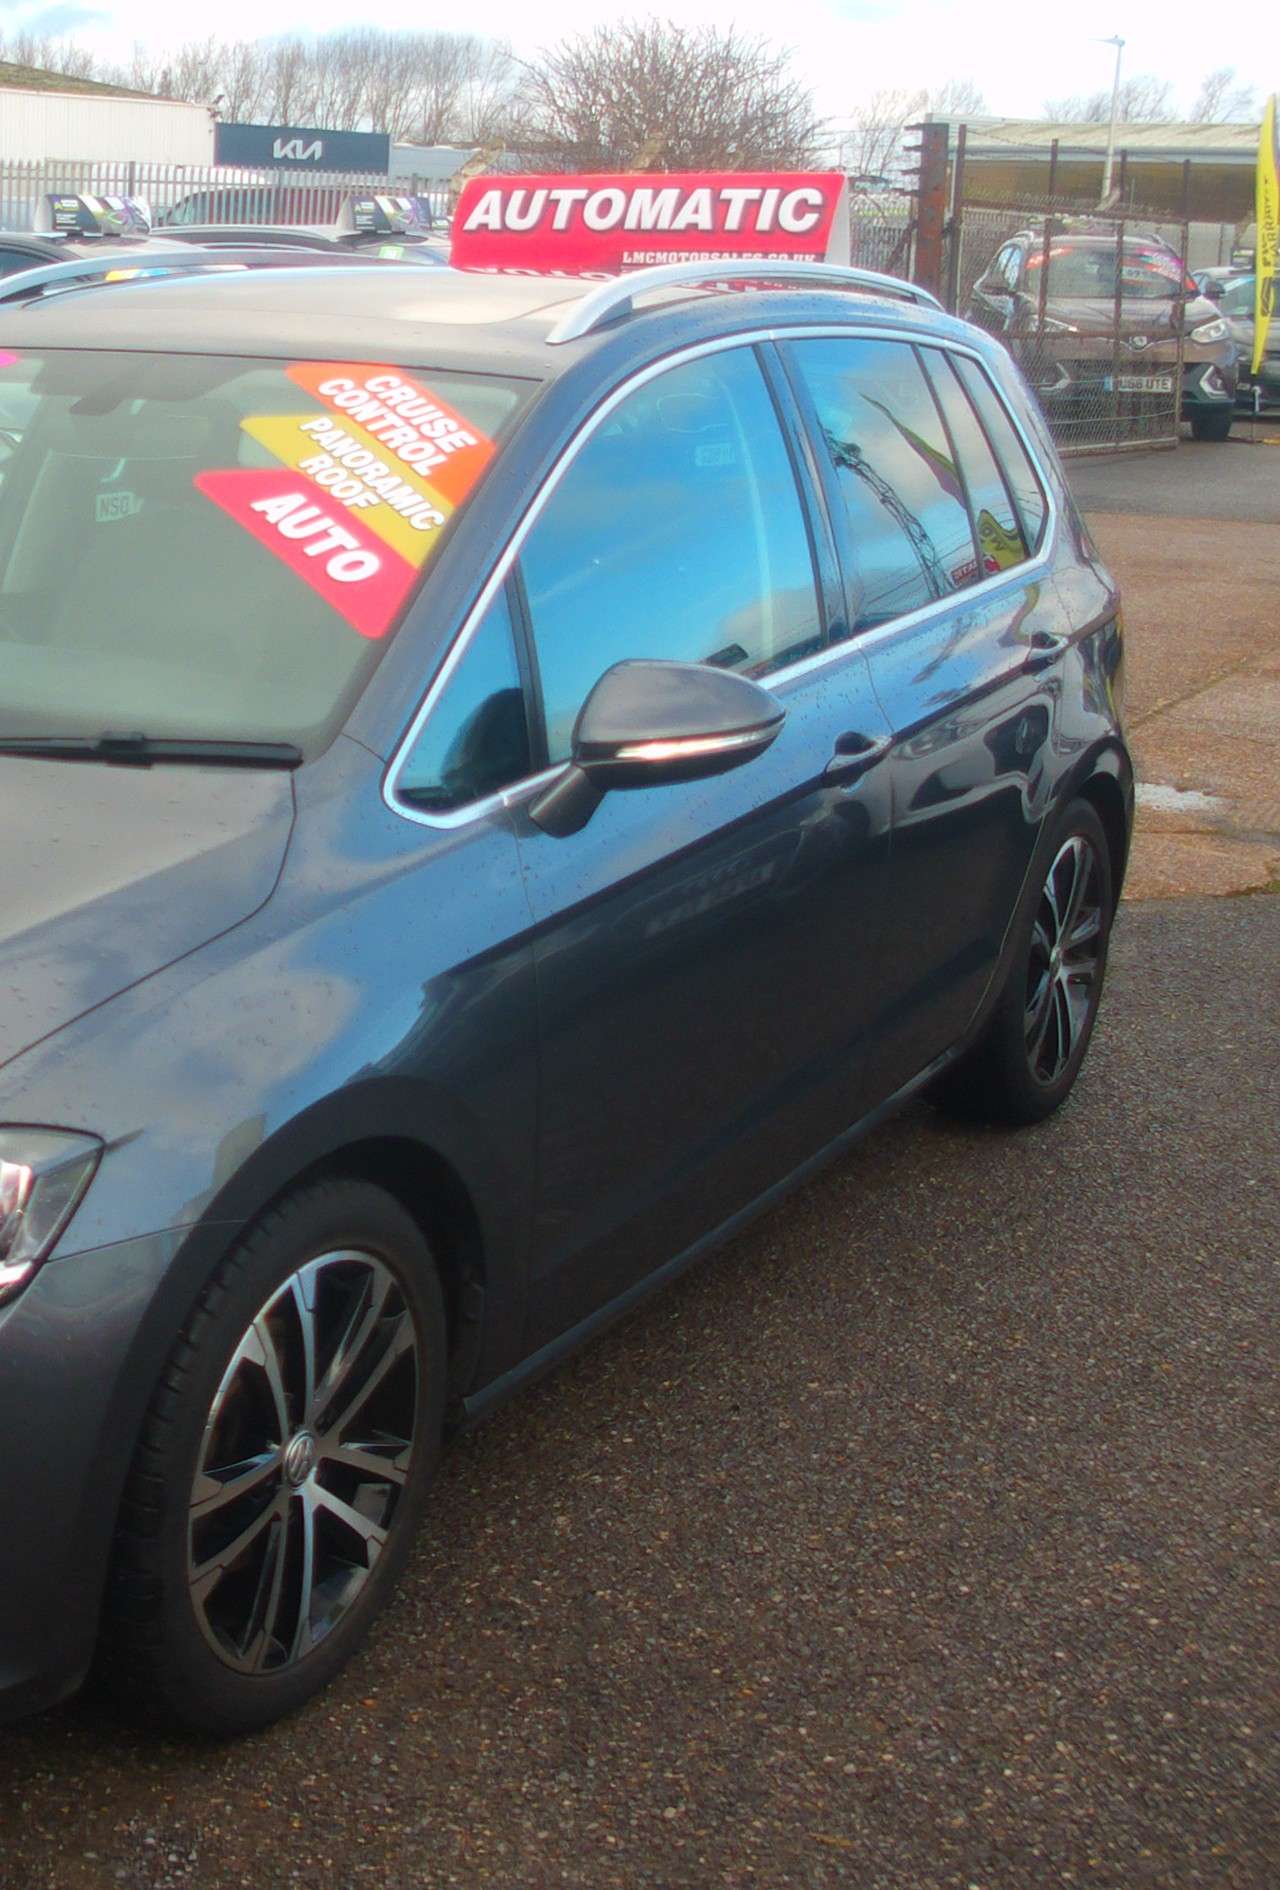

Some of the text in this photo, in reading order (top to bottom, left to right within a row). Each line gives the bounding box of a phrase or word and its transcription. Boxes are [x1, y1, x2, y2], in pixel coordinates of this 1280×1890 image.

[273, 138, 322, 161] KIA
[463, 188, 823, 233] AUTOMATIC
[318, 378, 447, 476] CONTROL
[364, 375, 477, 453] CRUISE
[297, 455, 380, 508] ROOF
[299, 416, 445, 531] PANORAMIC
[250, 492, 380, 582] AUTO
